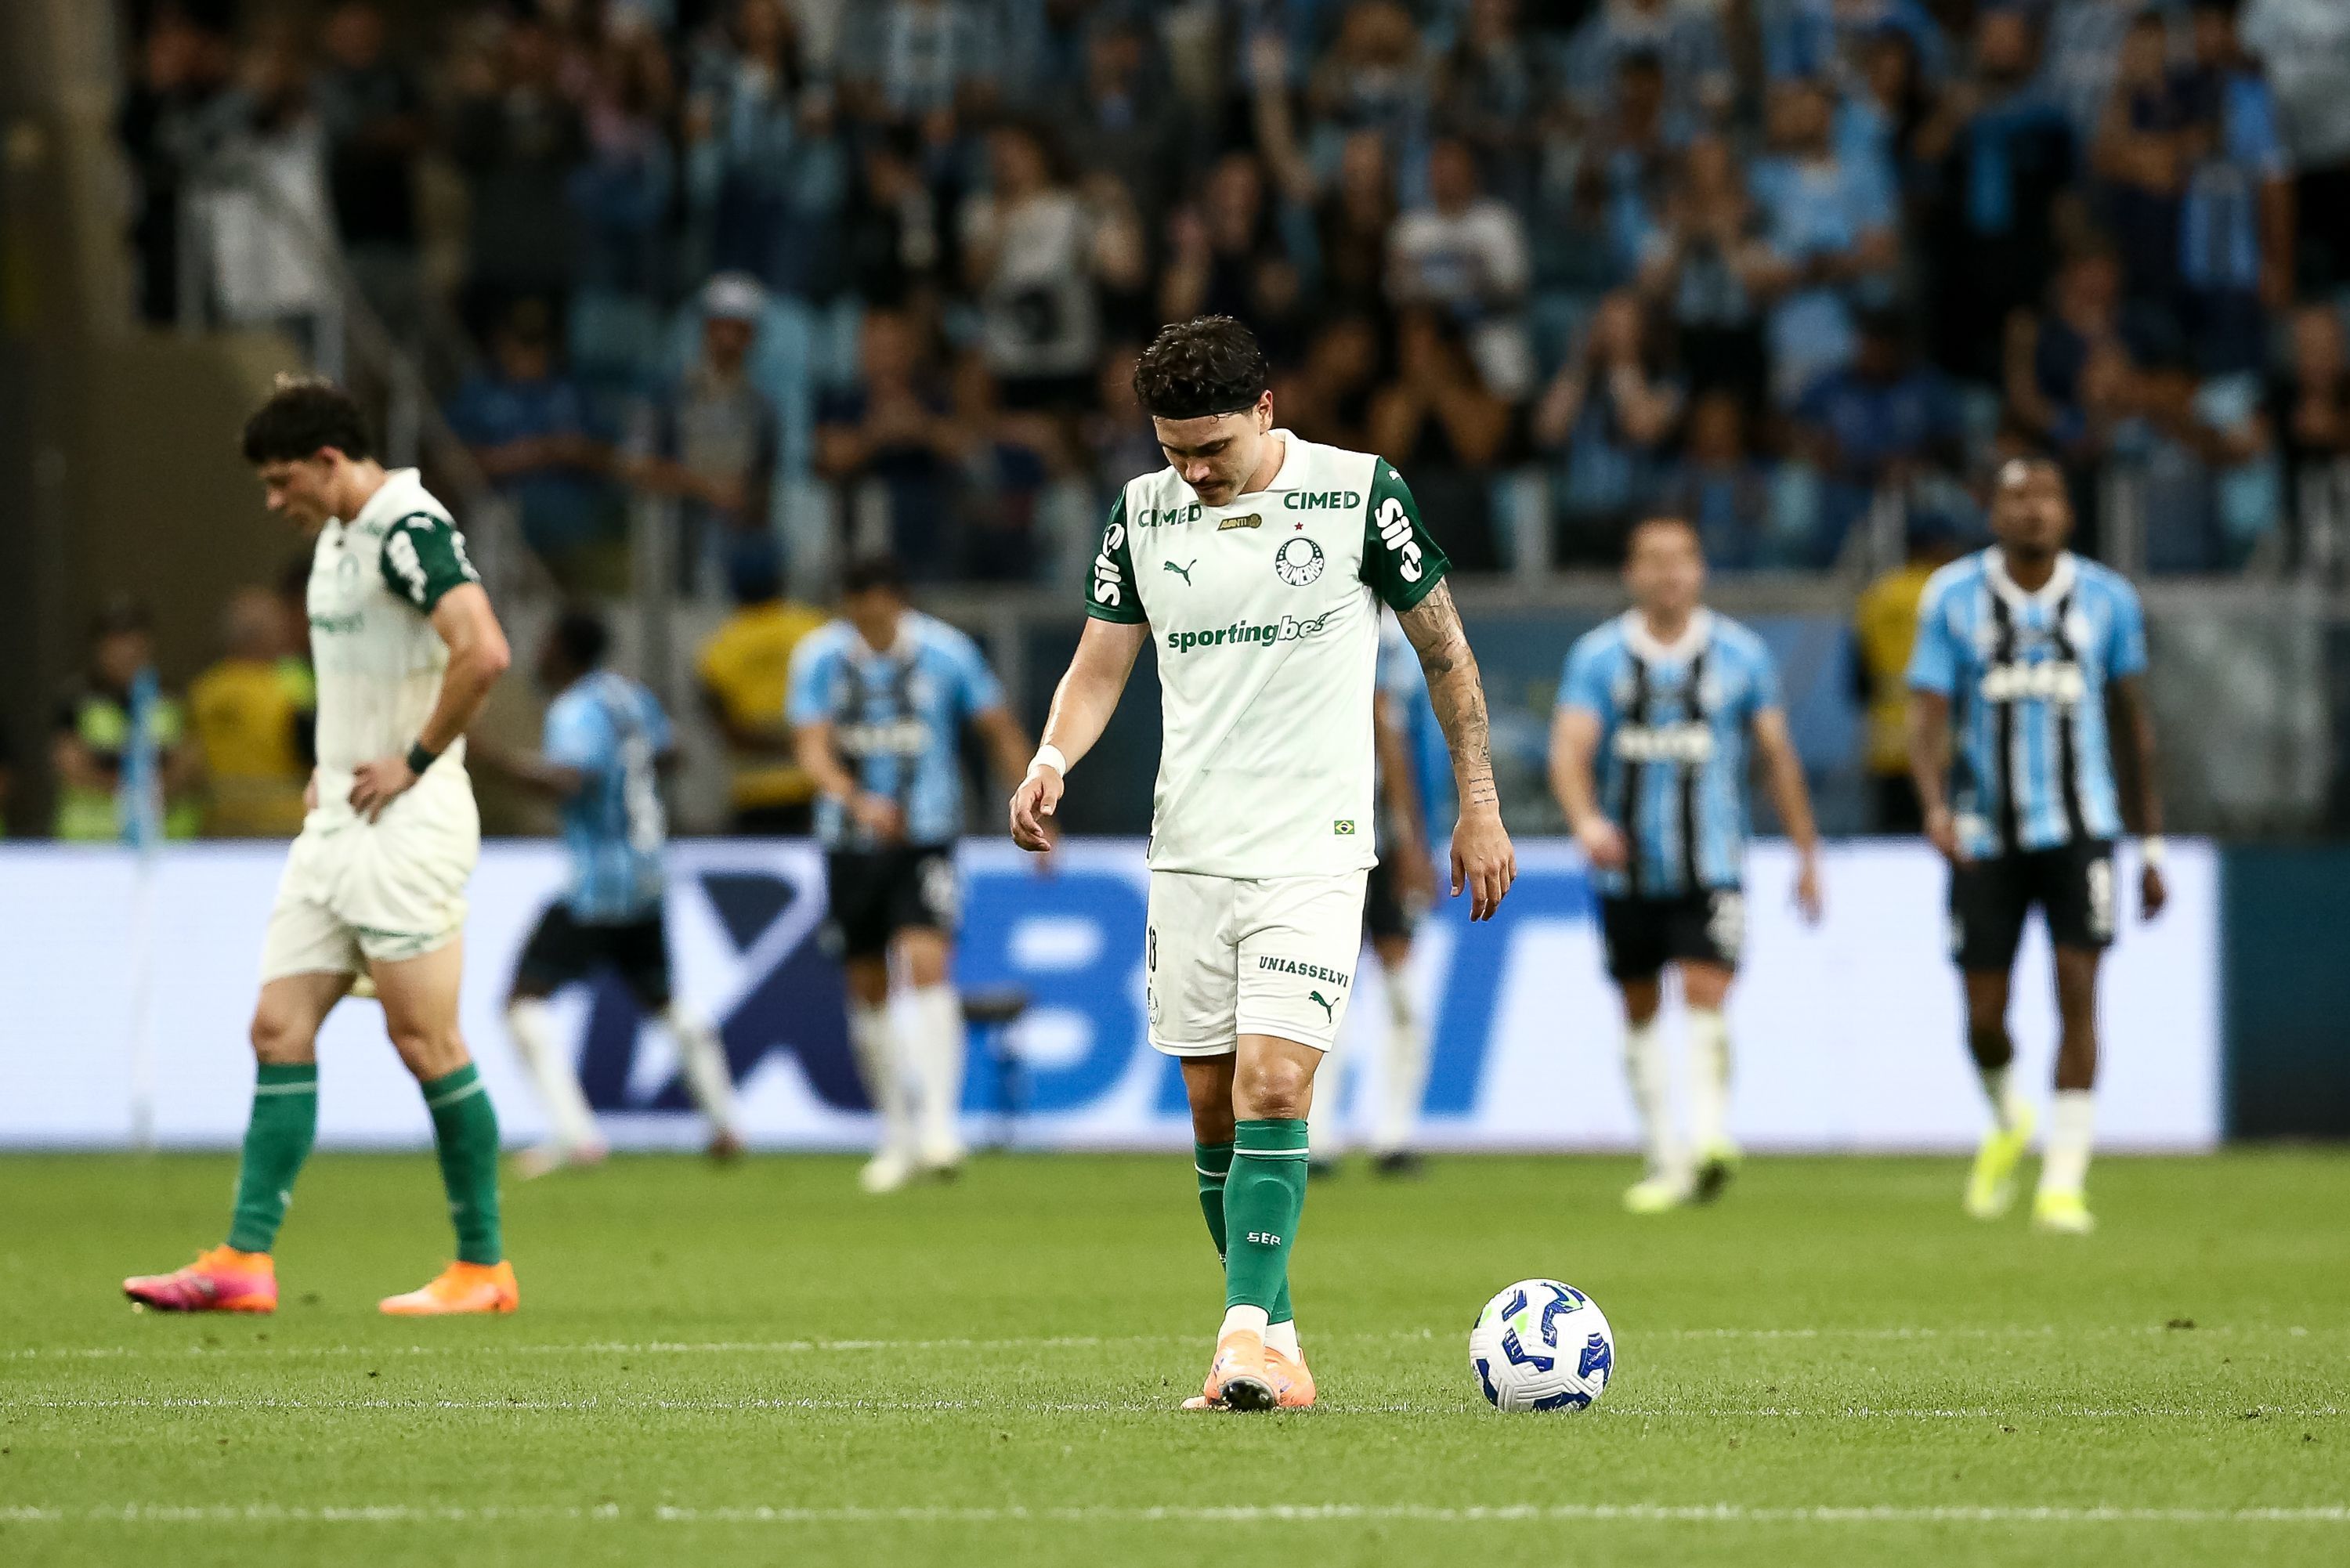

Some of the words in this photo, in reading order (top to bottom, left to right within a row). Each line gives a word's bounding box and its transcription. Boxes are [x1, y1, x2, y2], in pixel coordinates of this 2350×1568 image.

[1284, 491, 1361, 509] CIMED
[1137, 504, 1202, 527] CIMED
[1259, 956, 1348, 988] UNIASSELVI
